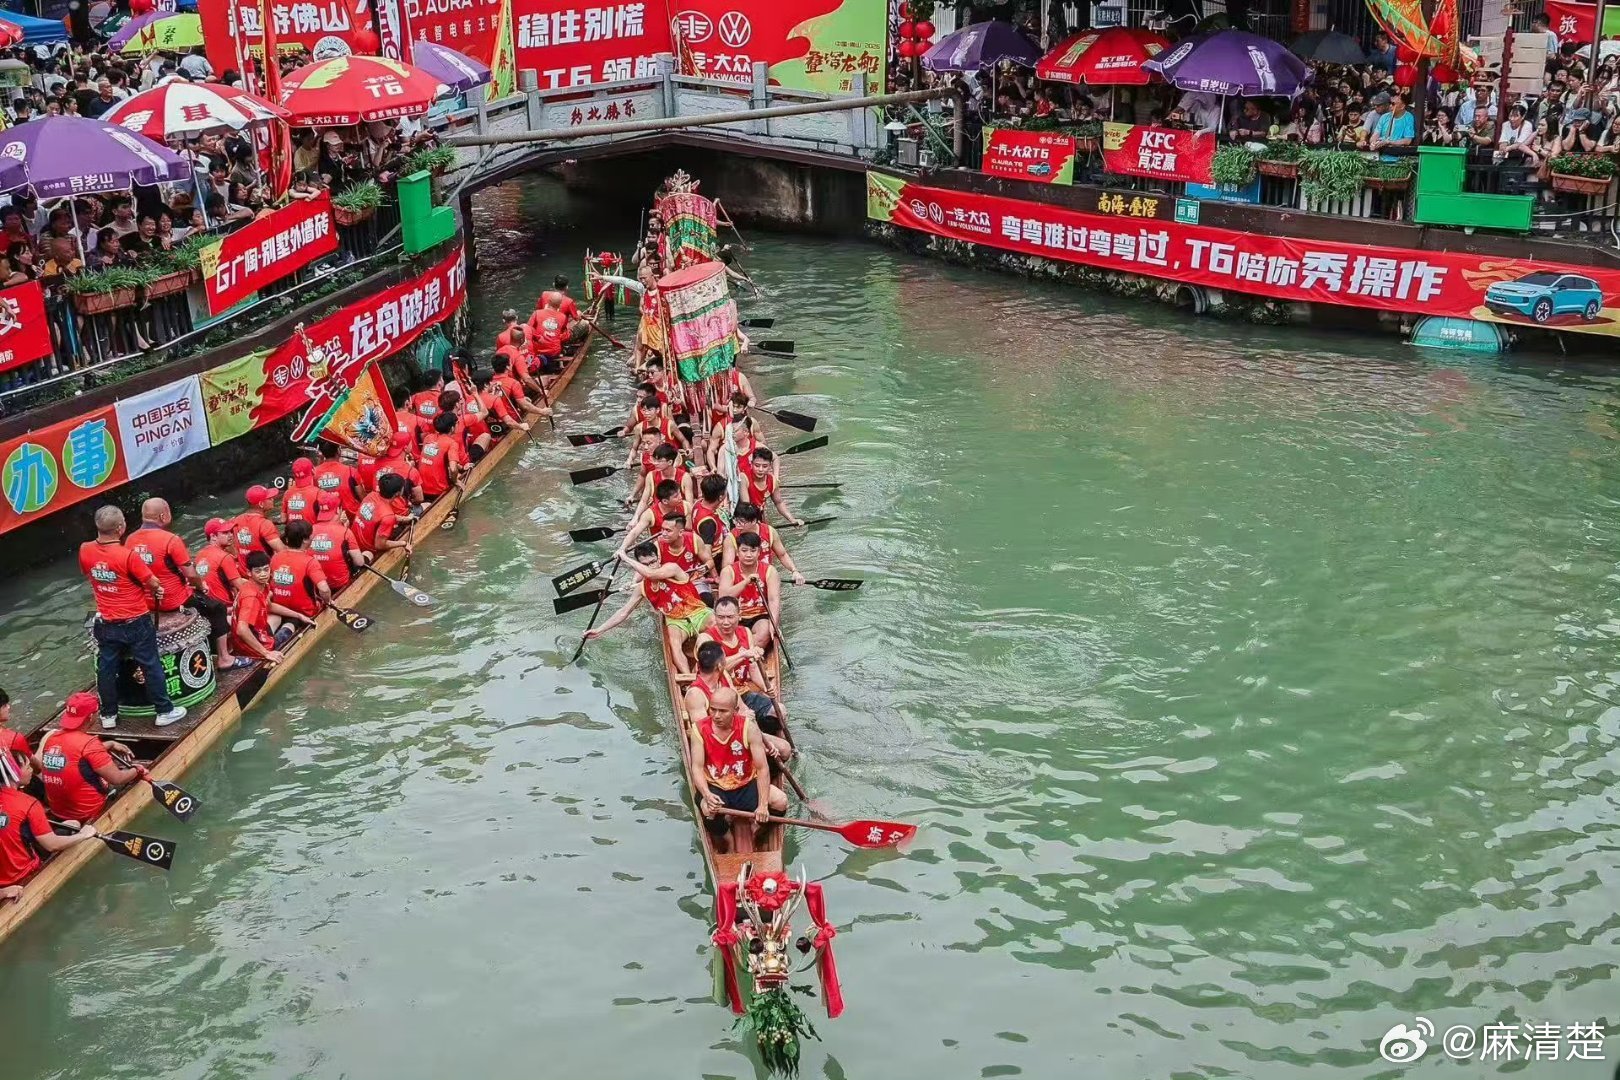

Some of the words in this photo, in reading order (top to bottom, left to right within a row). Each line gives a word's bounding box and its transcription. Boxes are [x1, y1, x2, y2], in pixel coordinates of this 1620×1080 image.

[518, 3, 645, 48] 稳住别慌
[1140, 131, 1176, 150] KFC
[1138, 147, 1177, 172] 肯定赢
[69, 173, 114, 187] 百岁山
[132, 397, 190, 429] 中国平安
